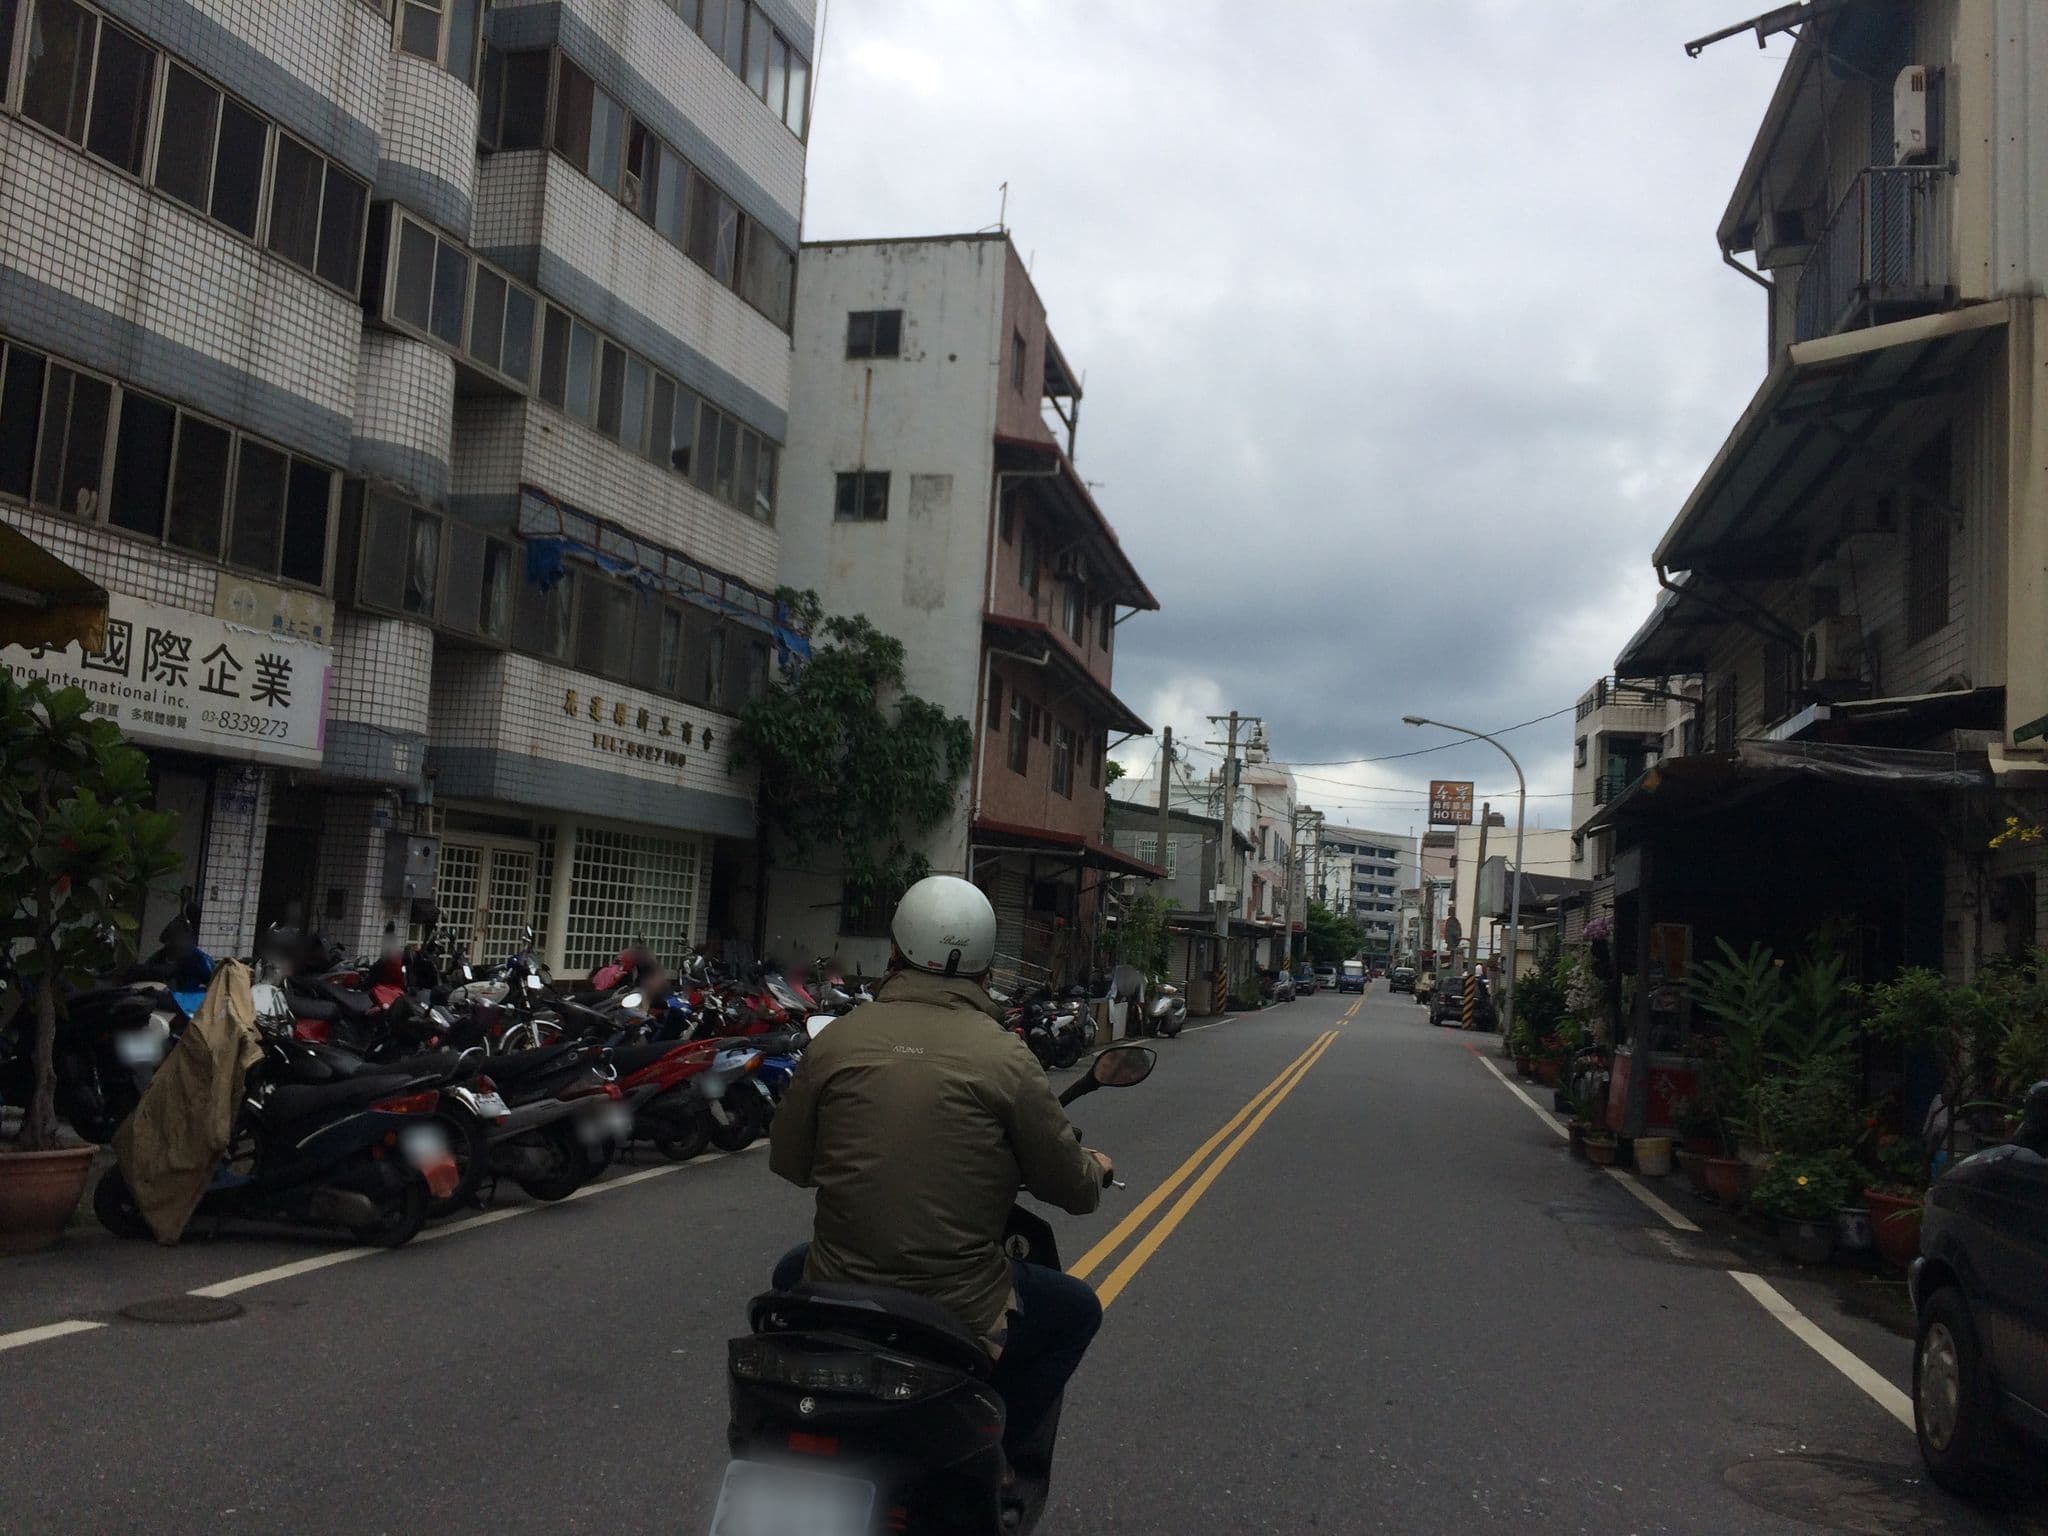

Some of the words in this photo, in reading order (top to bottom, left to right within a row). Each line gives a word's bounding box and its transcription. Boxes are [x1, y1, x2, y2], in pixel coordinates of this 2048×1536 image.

[30, 619, 294, 708] 國際企業
[46, 668, 157, 704] International
[163, 691, 190, 709] inc.
[201, 709, 289, 738] 03-8339273
[1433, 810, 1471, 820] HOTEL
